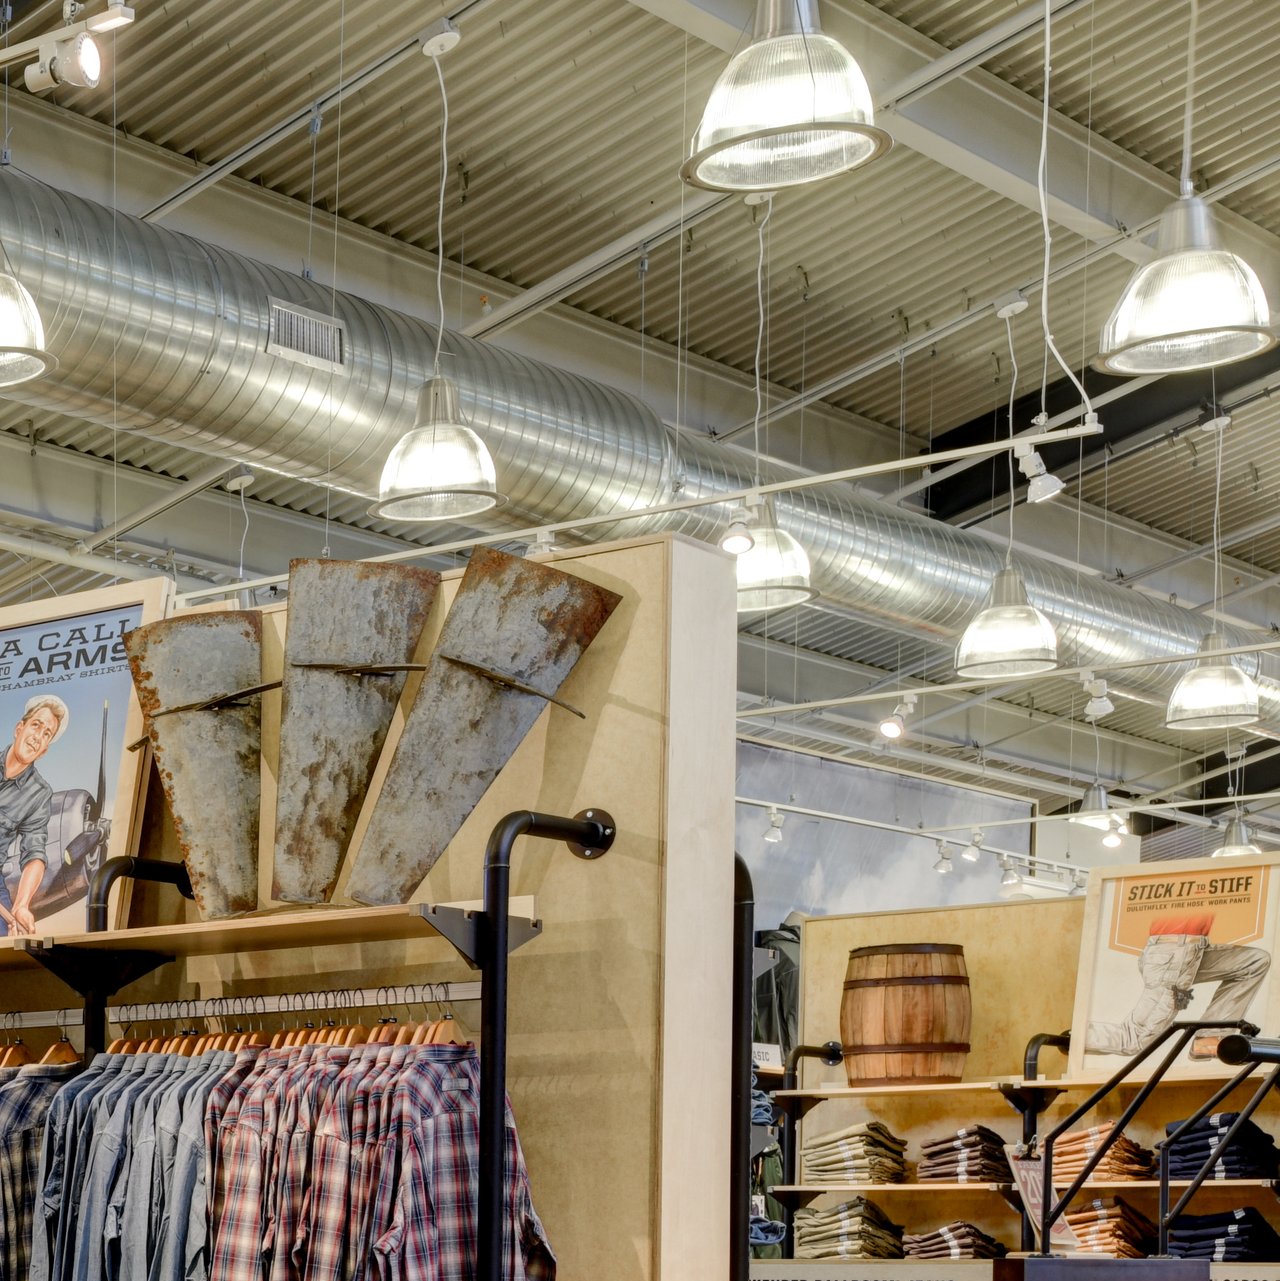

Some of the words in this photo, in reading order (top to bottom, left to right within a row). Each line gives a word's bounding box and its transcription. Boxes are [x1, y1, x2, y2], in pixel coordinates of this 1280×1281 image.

[18, 642, 130, 679] ARMS
[80, 663, 132, 679] SHIRTS
[1128, 882, 1176, 902] STICK
[1176, 880, 1196, 897] IT
[1208, 876, 1253, 894] STIFF
[1229, 896, 1251, 904] PANTS
